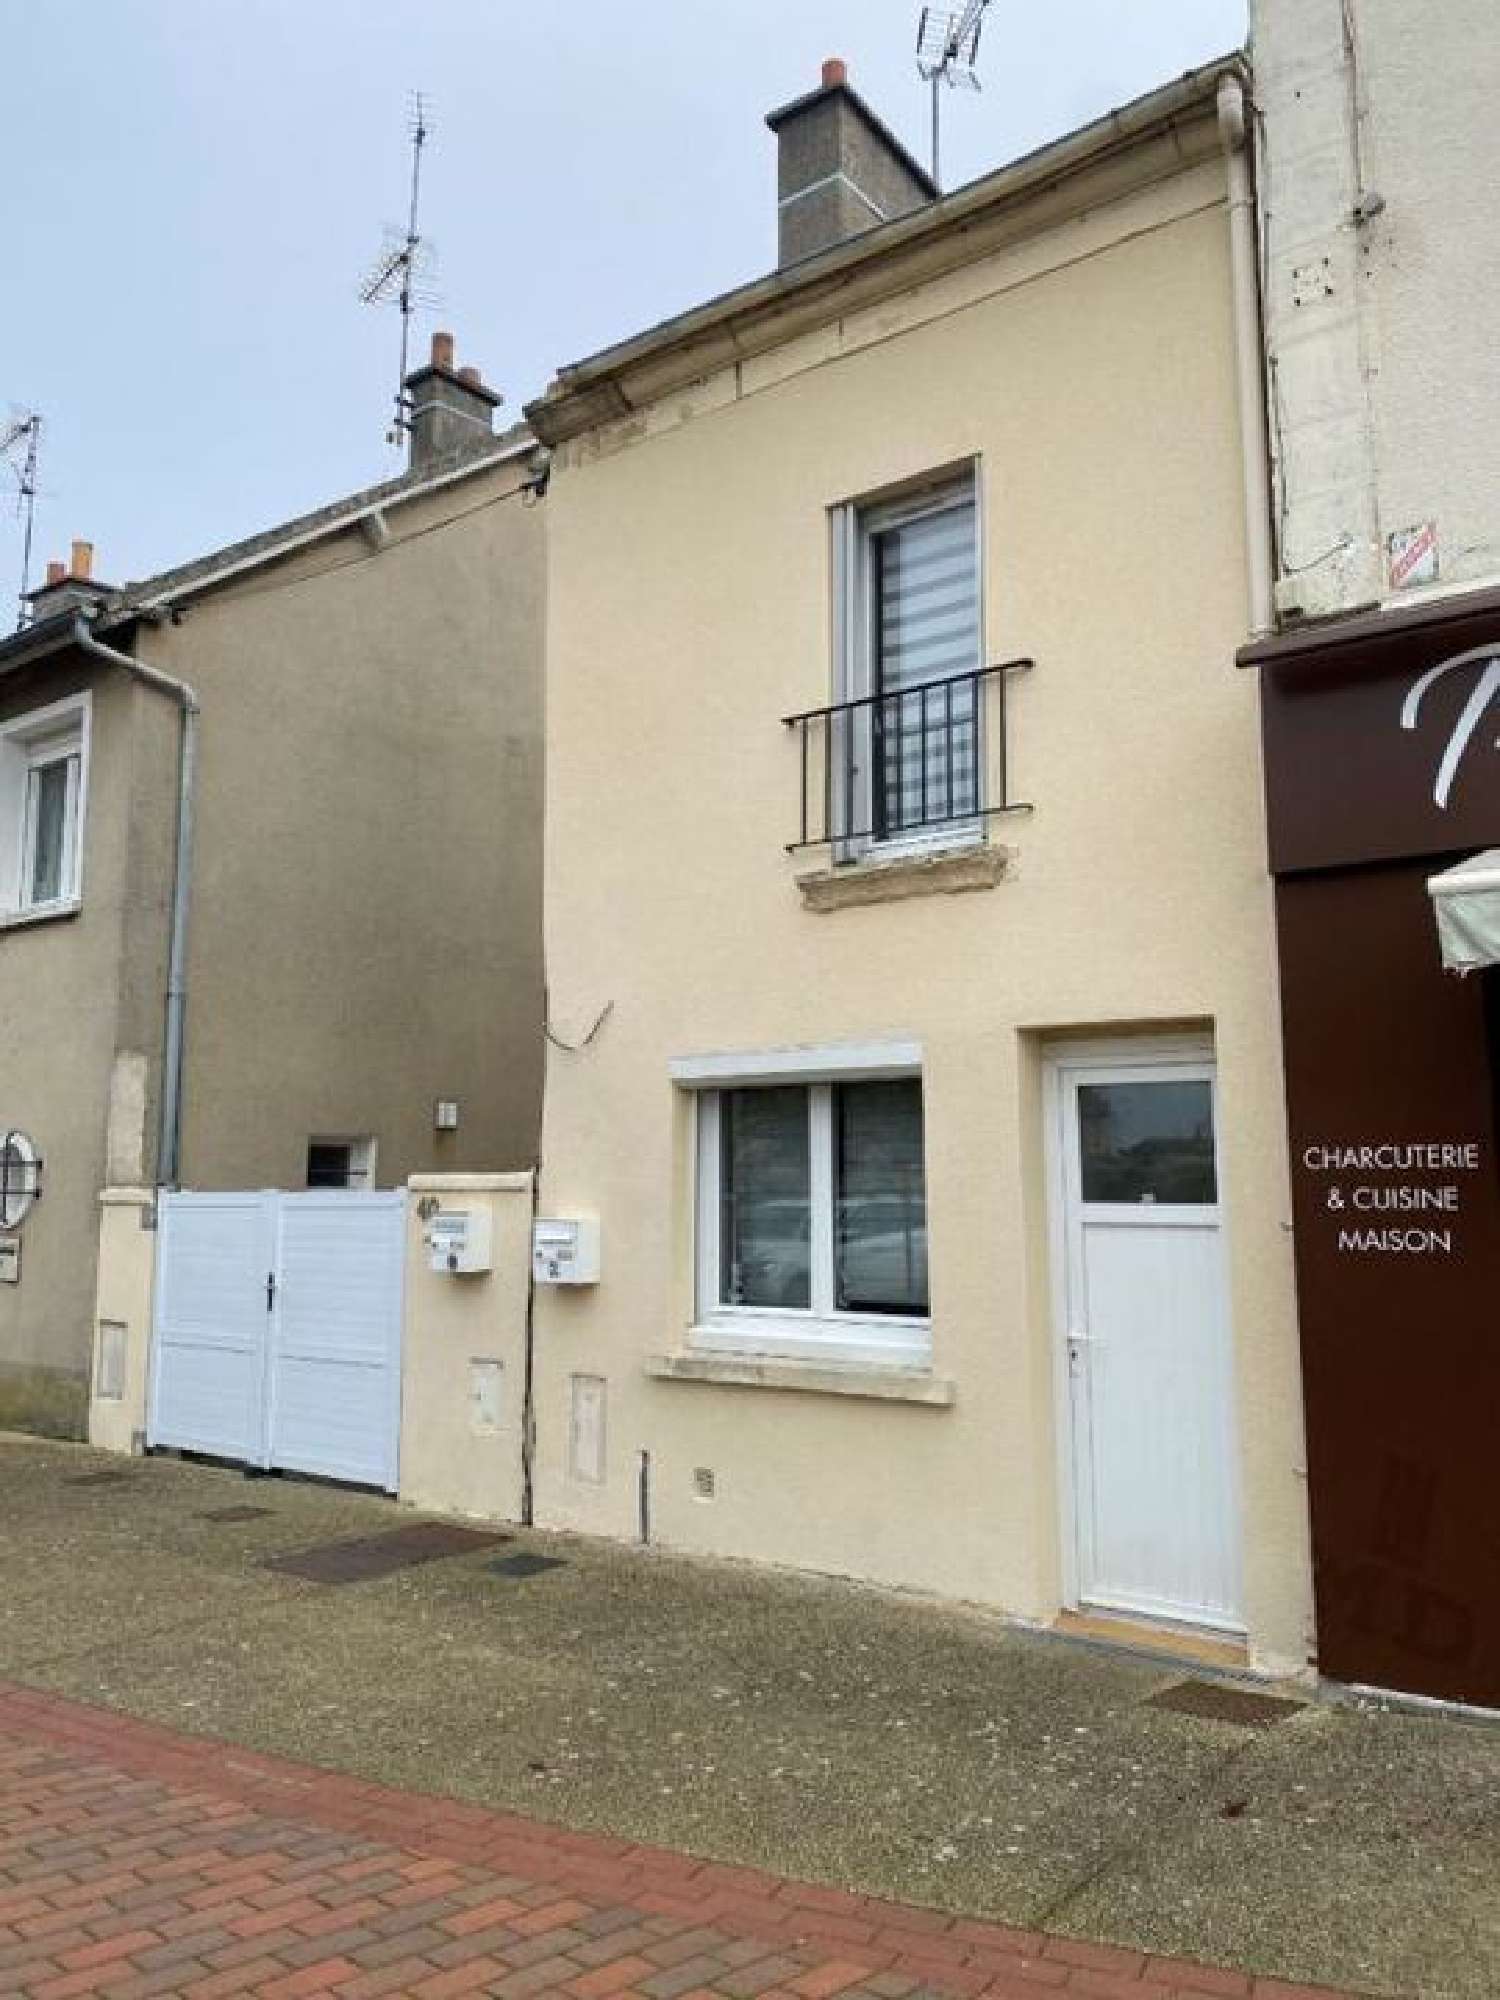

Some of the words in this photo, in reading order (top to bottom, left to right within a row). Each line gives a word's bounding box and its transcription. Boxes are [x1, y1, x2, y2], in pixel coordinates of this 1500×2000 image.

[1303, 1143, 1479, 1170] CHARCUTERIE
[1327, 1186, 1345, 1211] &
[1353, 1185, 1459, 1212] CUISINE
[1338, 1228, 1451, 1253] MAISON
